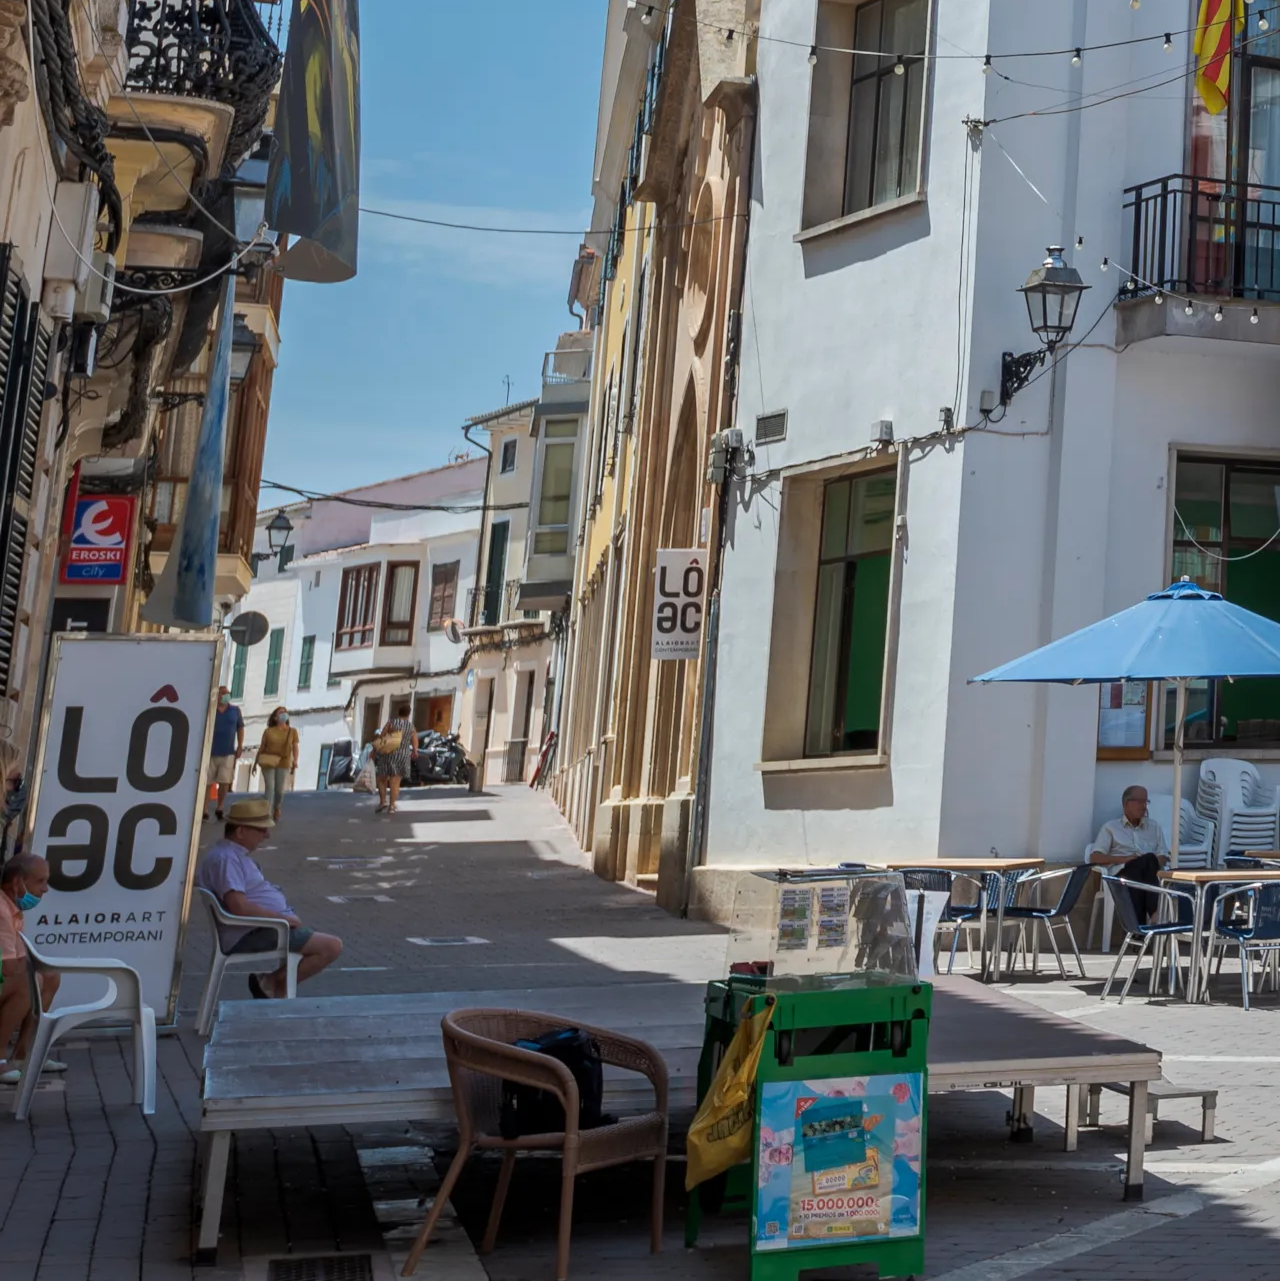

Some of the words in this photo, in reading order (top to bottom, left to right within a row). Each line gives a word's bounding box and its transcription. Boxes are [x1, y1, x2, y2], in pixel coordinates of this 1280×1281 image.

[72, 550, 120, 561] EROSKI
[81, 565, 106, 577] city
[658, 558, 704, 598] LÔ
[57, 684, 190, 793] LÔ
[34, 930, 163, 945] CONTEMPORANI
